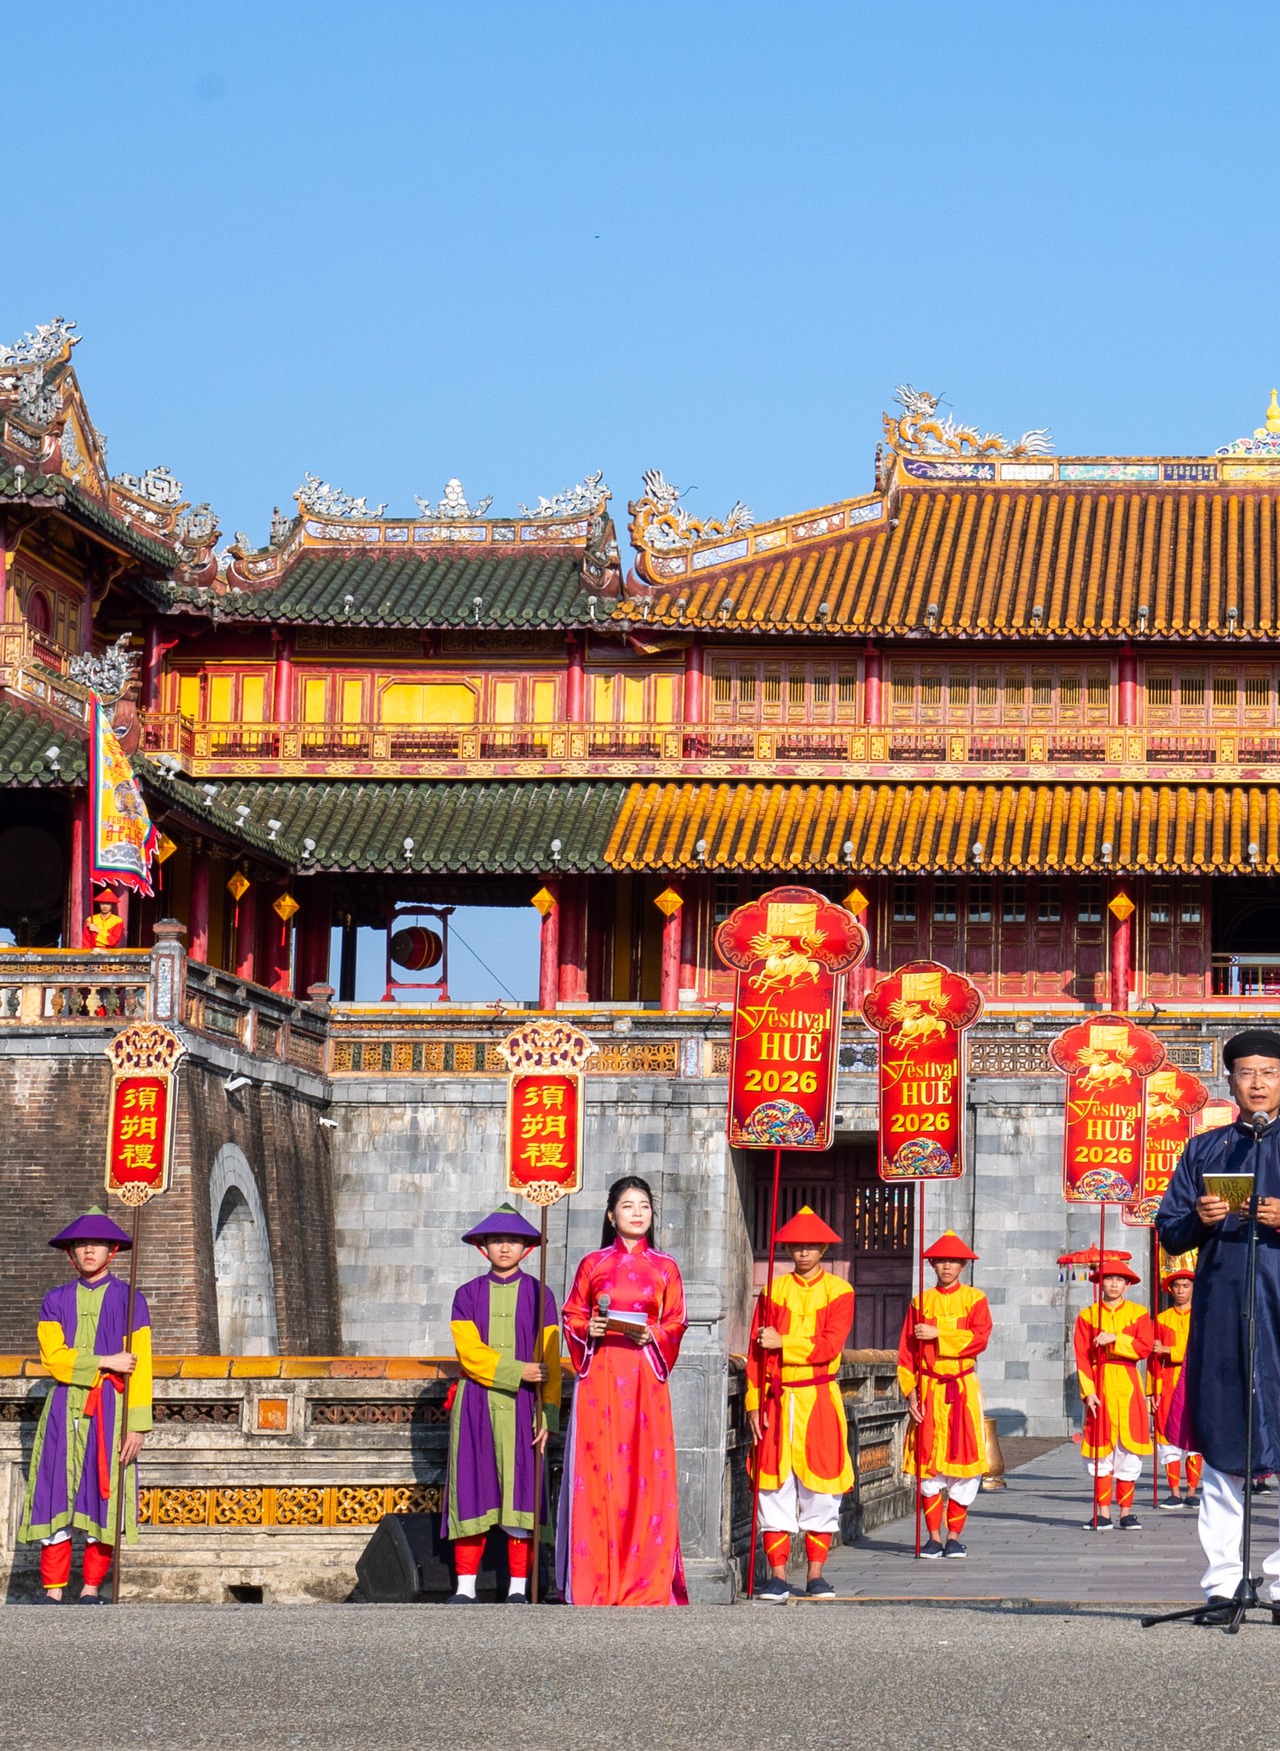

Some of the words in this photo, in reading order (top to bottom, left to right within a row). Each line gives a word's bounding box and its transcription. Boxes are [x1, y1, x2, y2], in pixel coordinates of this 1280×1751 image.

[736, 989, 831, 1041] Festival
[882, 1045, 958, 1092] Festival
[744, 1069, 818, 1094] 2026
[1067, 1088, 1142, 1126] Festival
[890, 1112, 951, 1133] 2026
[1074, 1146, 1133, 1164] 2026
[1146, 1136, 1189, 1154] estiva
[1145, 1176, 1169, 1191] 02
